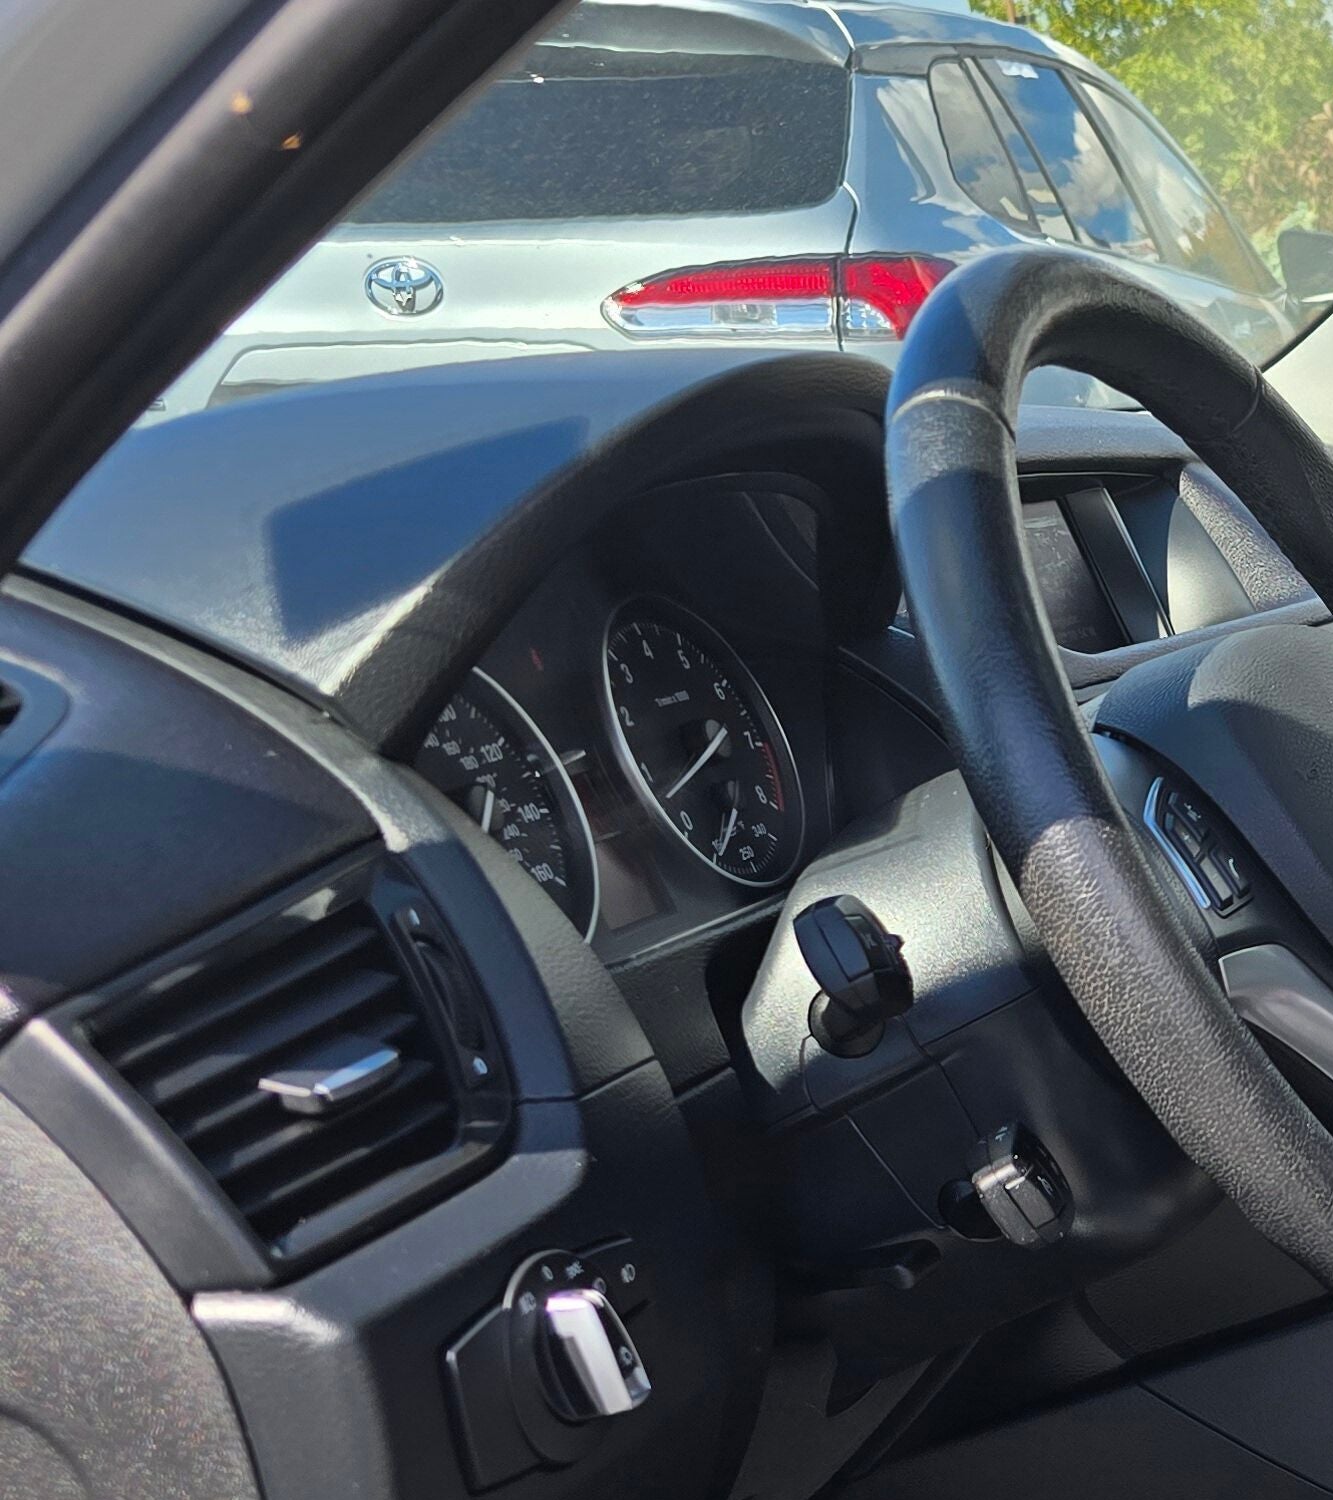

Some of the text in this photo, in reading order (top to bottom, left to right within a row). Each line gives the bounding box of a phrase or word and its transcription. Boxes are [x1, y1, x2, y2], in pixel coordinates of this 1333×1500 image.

[642, 639, 654, 660] 4
[677, 649, 690, 669] 5
[620, 663, 633, 684] 3
[713, 682, 725, 700] 6
[620, 706, 635, 727] 2
[743, 731, 756, 749] 7
[480, 743, 503, 763] 120
[755, 785, 767, 804] 8
[517, 802, 540, 824] 140
[531, 862, 554, 883] 160
